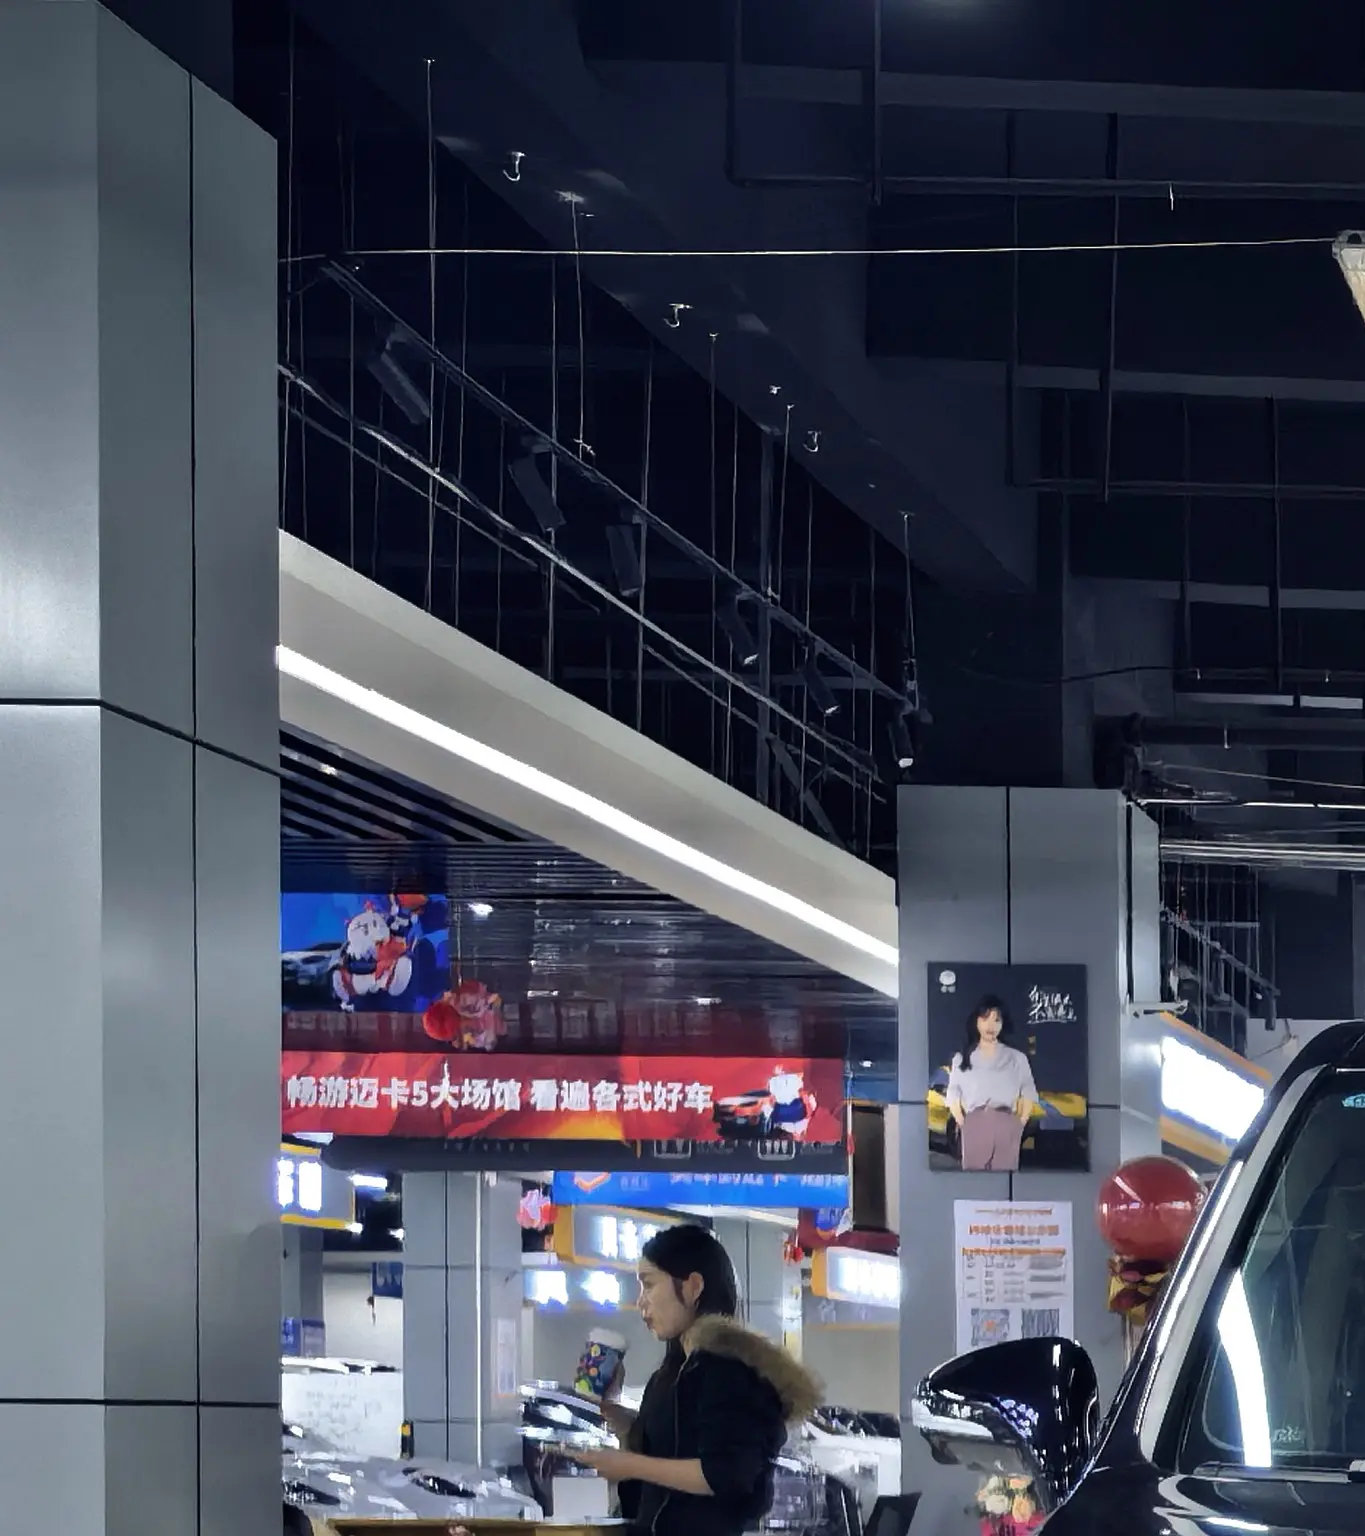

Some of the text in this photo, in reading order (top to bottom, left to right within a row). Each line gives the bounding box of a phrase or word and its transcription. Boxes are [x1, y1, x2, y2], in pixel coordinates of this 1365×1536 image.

[287, 1075, 713, 1113] 畅游迈卡5大场馆 看遍各式好车
